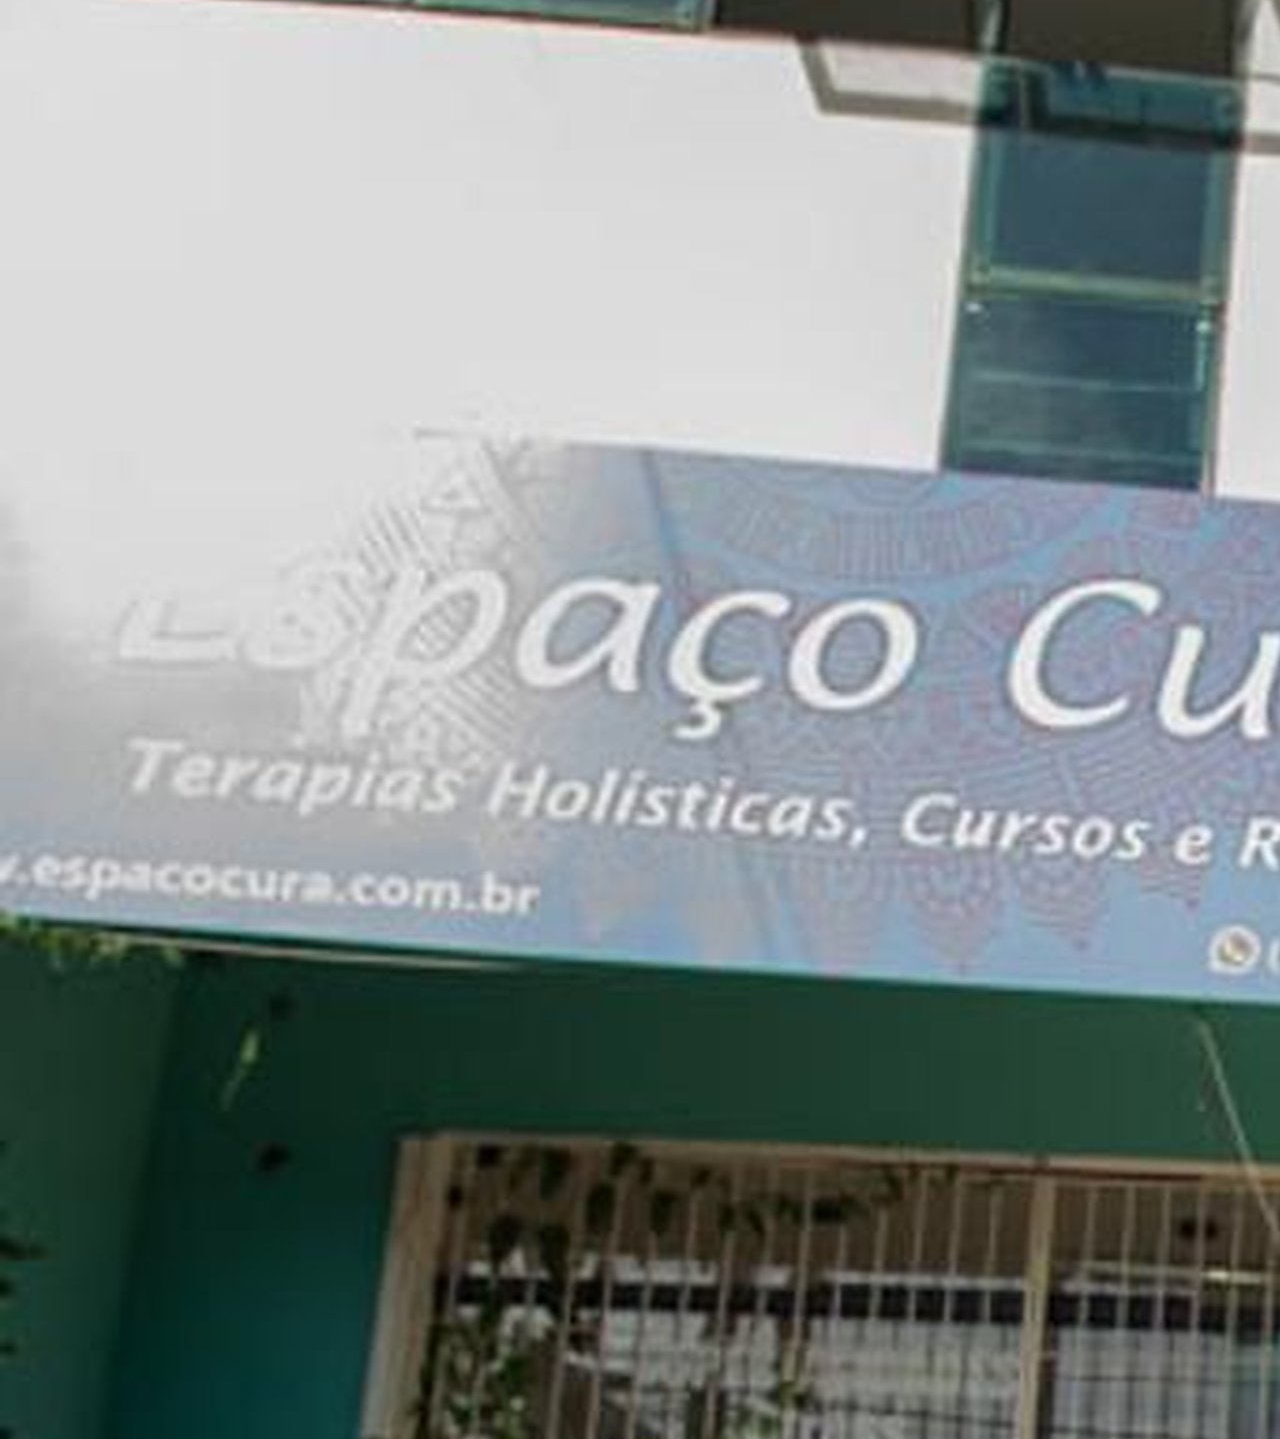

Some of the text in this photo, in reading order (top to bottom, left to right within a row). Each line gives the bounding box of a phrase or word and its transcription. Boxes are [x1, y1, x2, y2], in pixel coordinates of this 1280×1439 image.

[128, 737, 466, 817] Terapias
[902, 792, 1151, 860] Cursos
[1175, 824, 1212, 864] e
